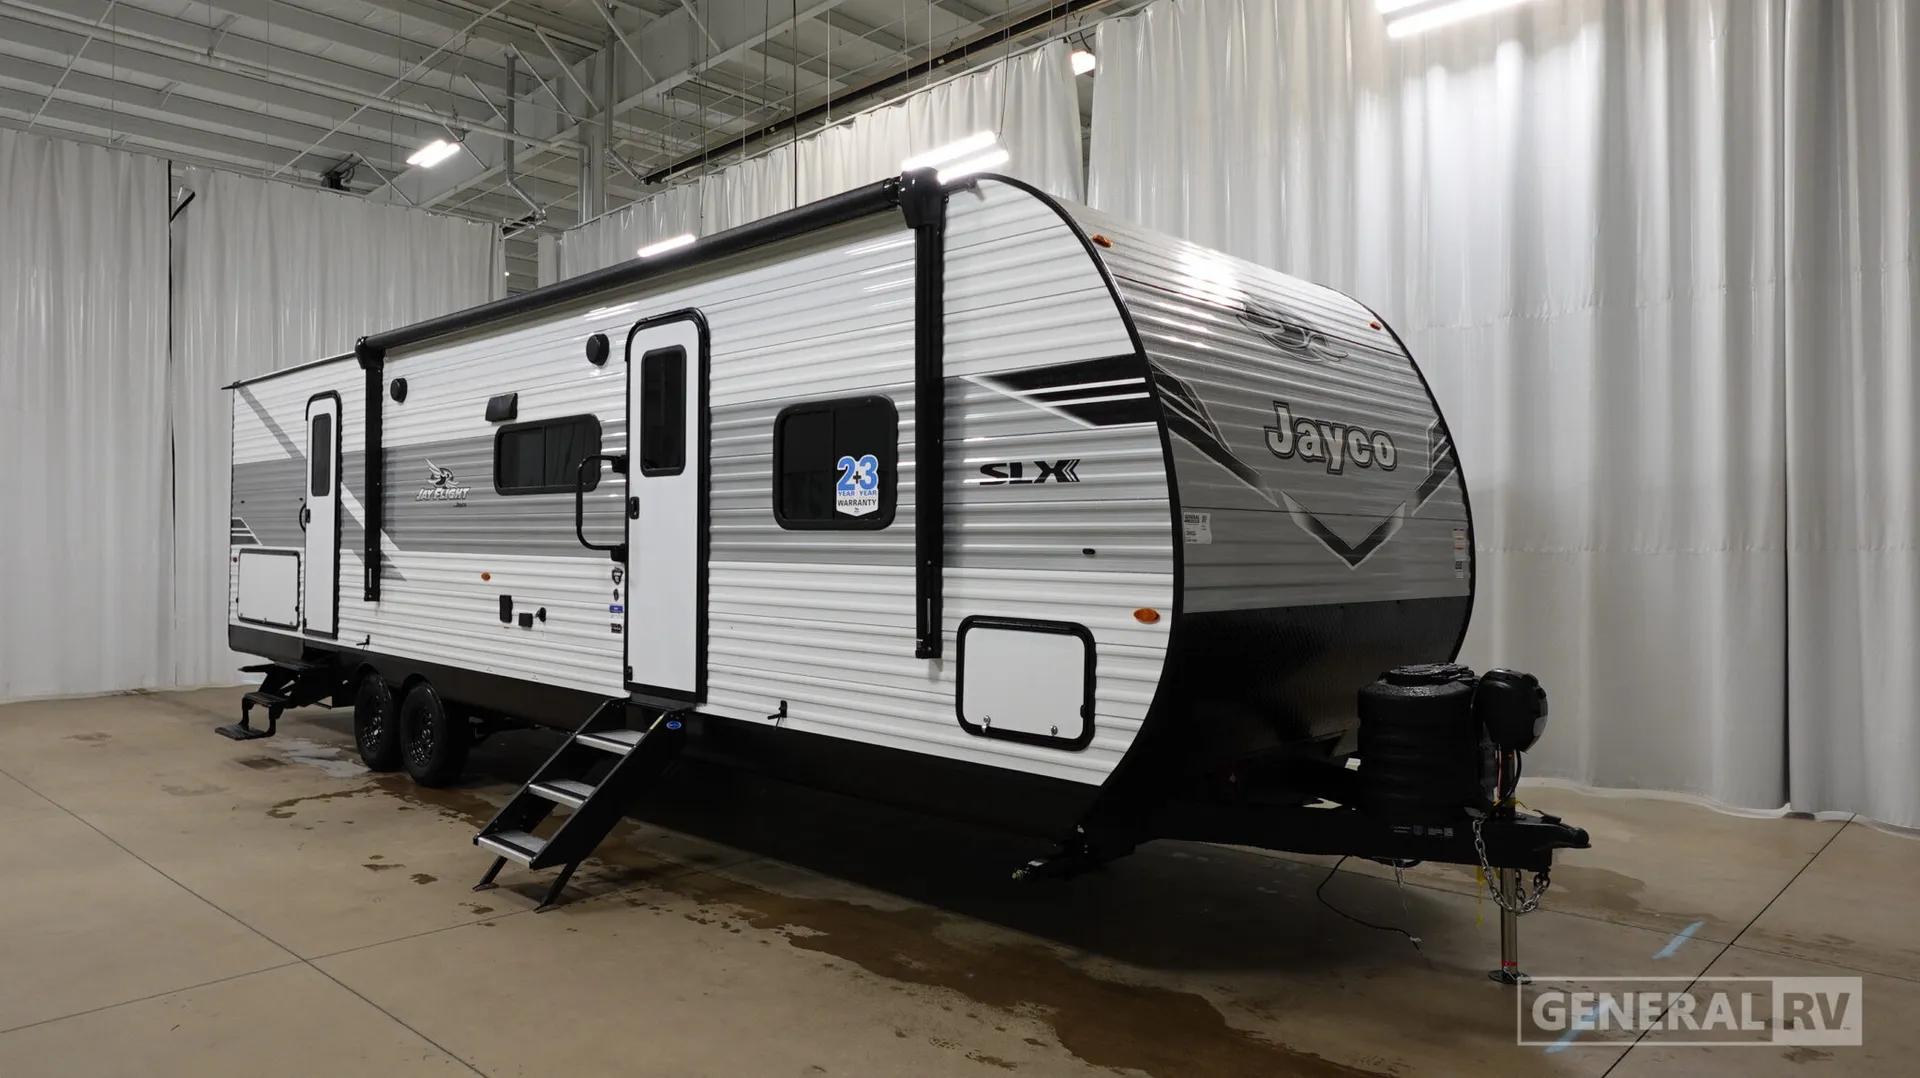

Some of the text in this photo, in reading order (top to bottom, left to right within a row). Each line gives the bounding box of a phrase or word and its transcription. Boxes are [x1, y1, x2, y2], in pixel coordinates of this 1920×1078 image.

[1263, 400, 1397, 475] Jayco
[979, 459, 1080, 485] SLX
[416, 487, 471, 501] JAY FLIGHT
